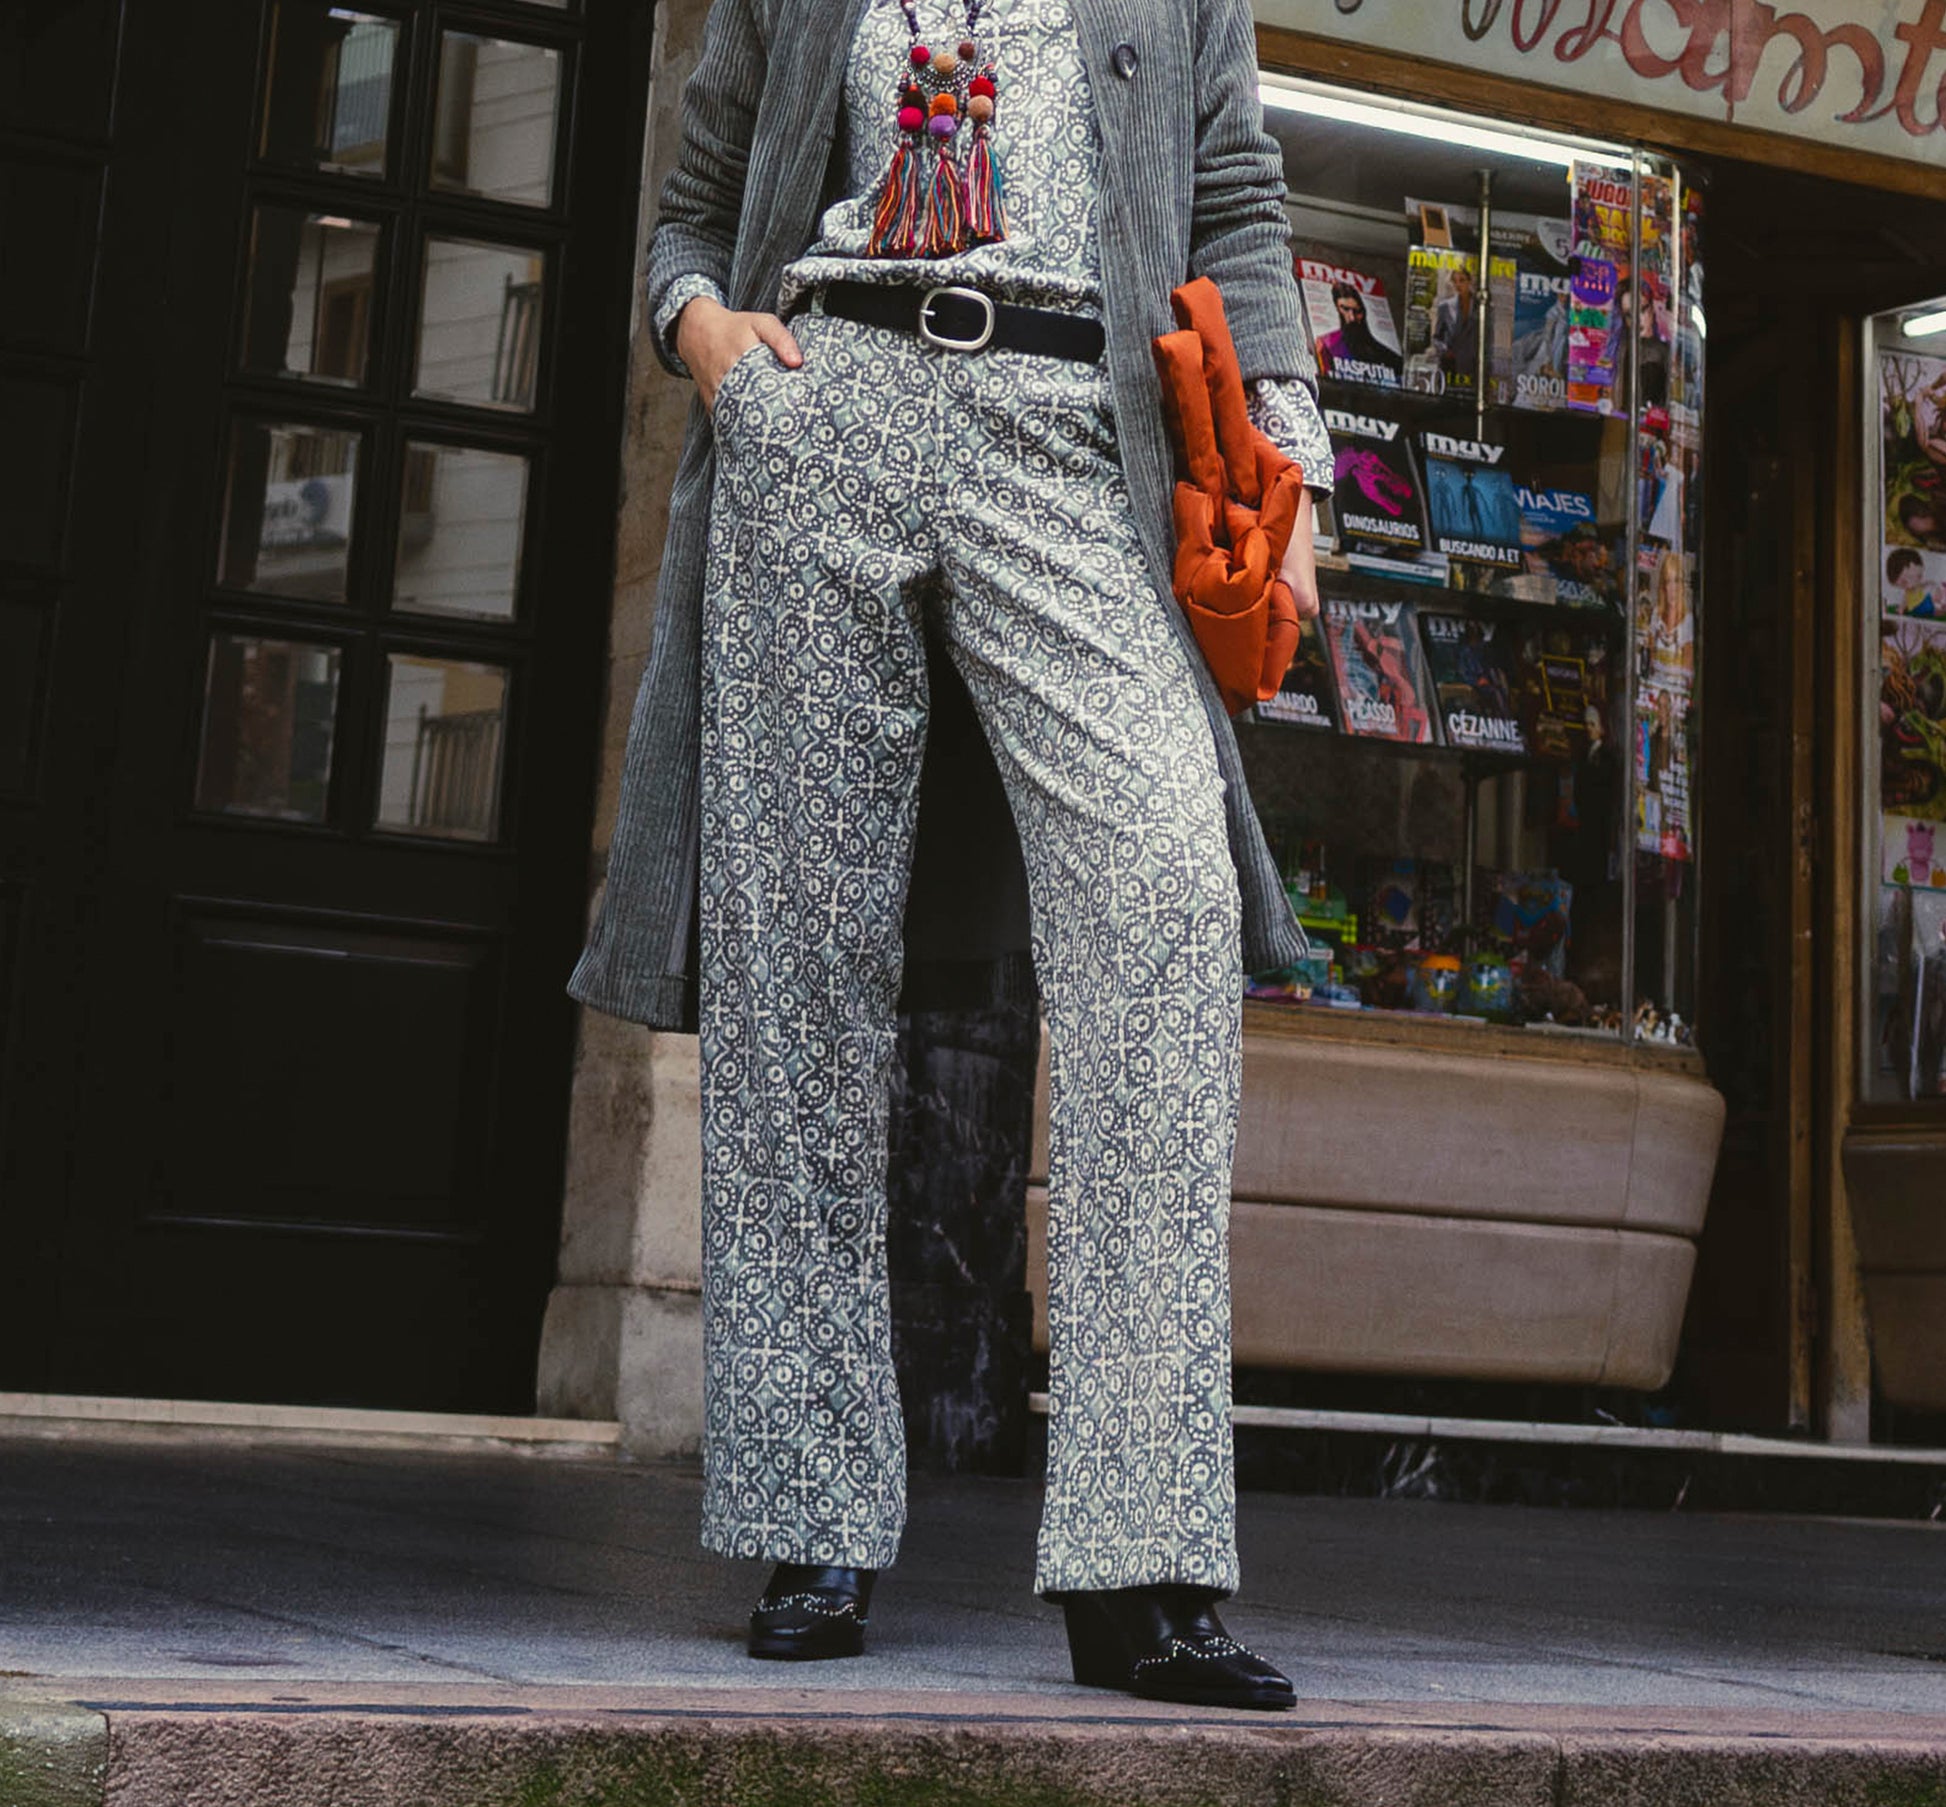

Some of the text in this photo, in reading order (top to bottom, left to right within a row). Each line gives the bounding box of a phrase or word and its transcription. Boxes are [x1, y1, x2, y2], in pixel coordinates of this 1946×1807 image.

[1300, 260, 1377, 294] muy
[1520, 272, 1568, 294] mu
[1516, 373, 1567, 399] SOROL
[1324, 409, 1400, 442] muy
[1426, 432, 1504, 464] muy
[1513, 488, 1590, 517] VIAJES
[1343, 512, 1420, 540] DINOSAURIOS
[1440, 538, 1520, 563] BUSCANDO A ET
[1328, 600, 1402, 625] muy
[1449, 709, 1521, 742] CÉZANNE
